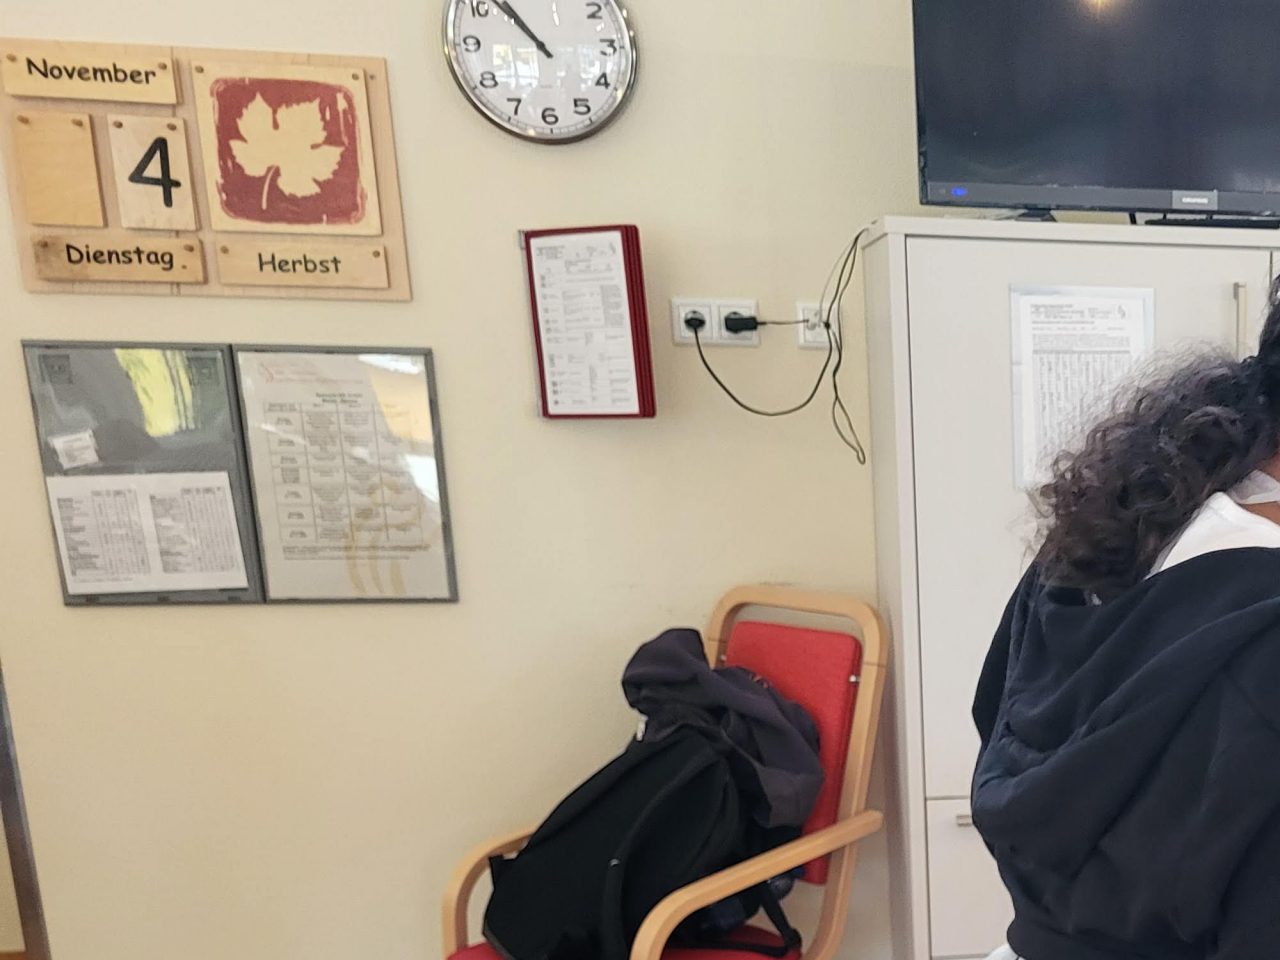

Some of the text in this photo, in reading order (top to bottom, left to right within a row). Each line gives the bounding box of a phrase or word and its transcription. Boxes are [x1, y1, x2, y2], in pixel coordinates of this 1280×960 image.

[586, 2, 602, 19] 2
[463, 35, 481, 52] 9
[600, 39, 617, 56] 3
[26, 58, 156, 84] November
[480, 71, 498, 88] 8
[595, 72, 611, 90] 4
[506, 98, 522, 116] 7
[573, 98, 591, 115] 5
[541, 107, 559, 125] 6
[128, 136, 182, 208] 4
[65, 244, 174, 270] Dienstag
[258, 252, 342, 275] Herbst
